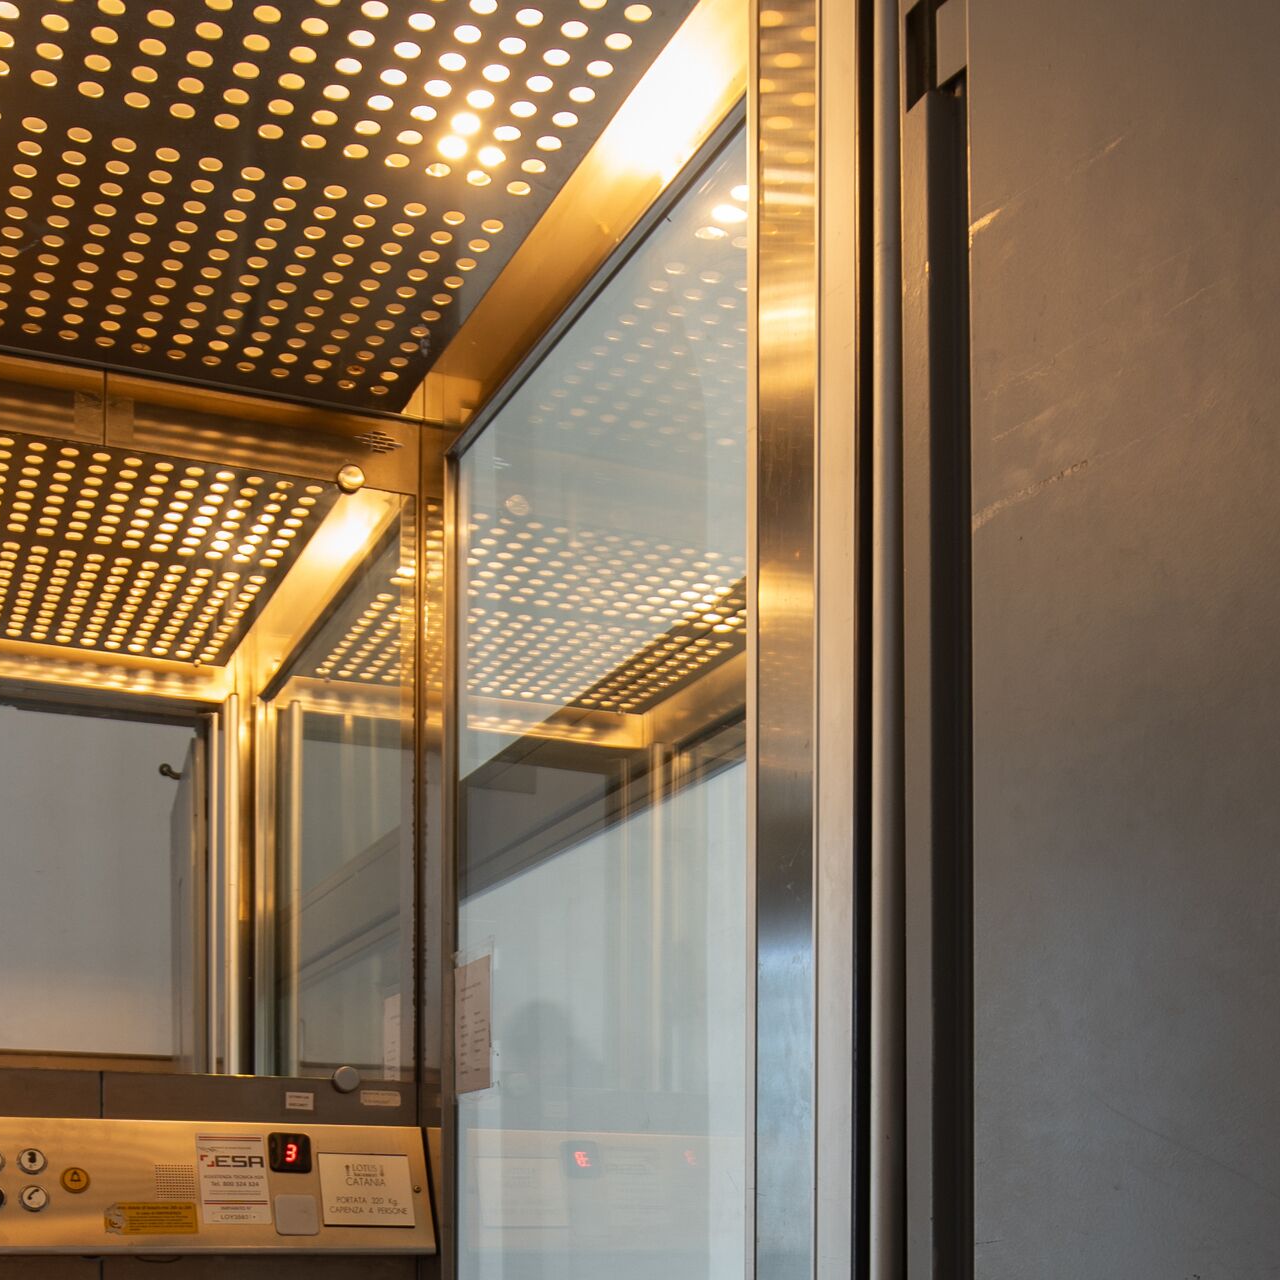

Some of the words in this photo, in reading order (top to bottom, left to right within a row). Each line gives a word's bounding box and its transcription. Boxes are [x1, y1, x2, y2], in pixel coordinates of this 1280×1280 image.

[27, 1151, 37, 1164] 3
[285, 1143, 298, 1163] 3
[352, 1163, 378, 1172] LOTUS
[345, 1177, 386, 1187] CATANIA
[336, 1196, 367, 1205] PORTATA
[329, 1206, 364, 1214] CAPIENZA
[377, 1206, 408, 1215] PERSONE
